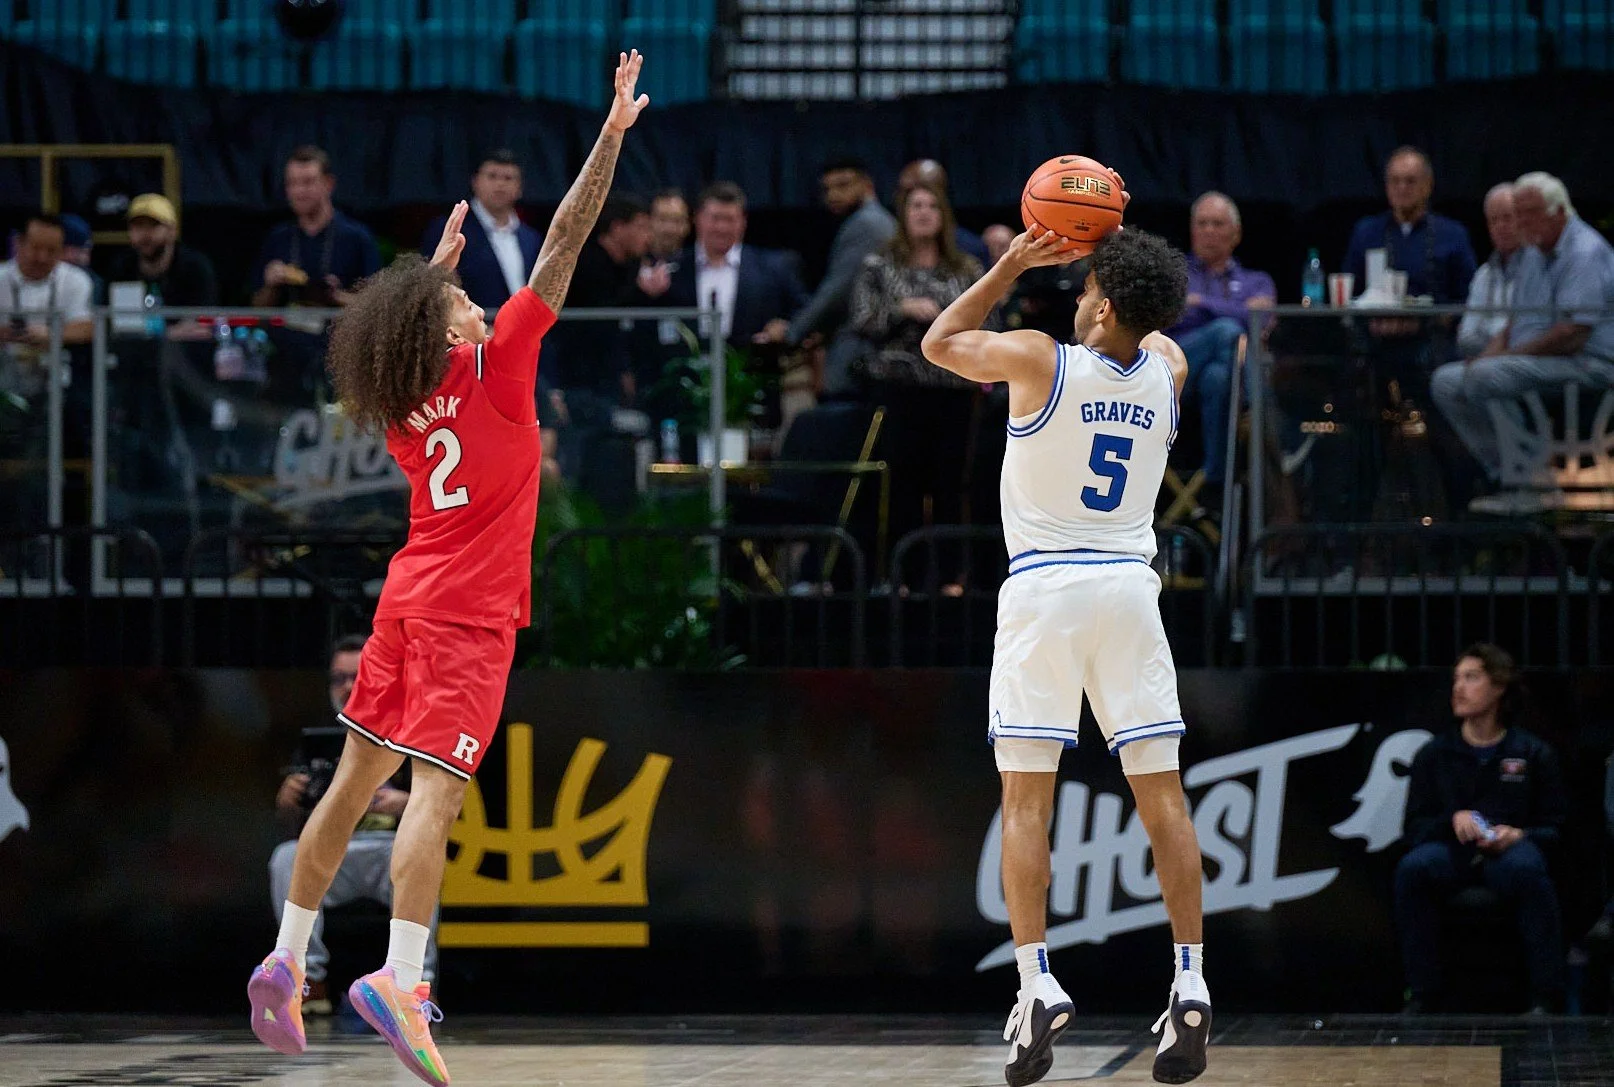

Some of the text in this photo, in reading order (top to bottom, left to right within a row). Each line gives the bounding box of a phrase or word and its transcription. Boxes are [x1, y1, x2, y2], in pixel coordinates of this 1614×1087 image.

[1061, 176, 1111, 197] ELITE
[407, 395, 462, 434] MARK
[1081, 401, 1155, 430] GRAVES
[425, 426, 470, 512] 2
[1080, 432, 1134, 513] 5
[451, 731, 481, 766] R
